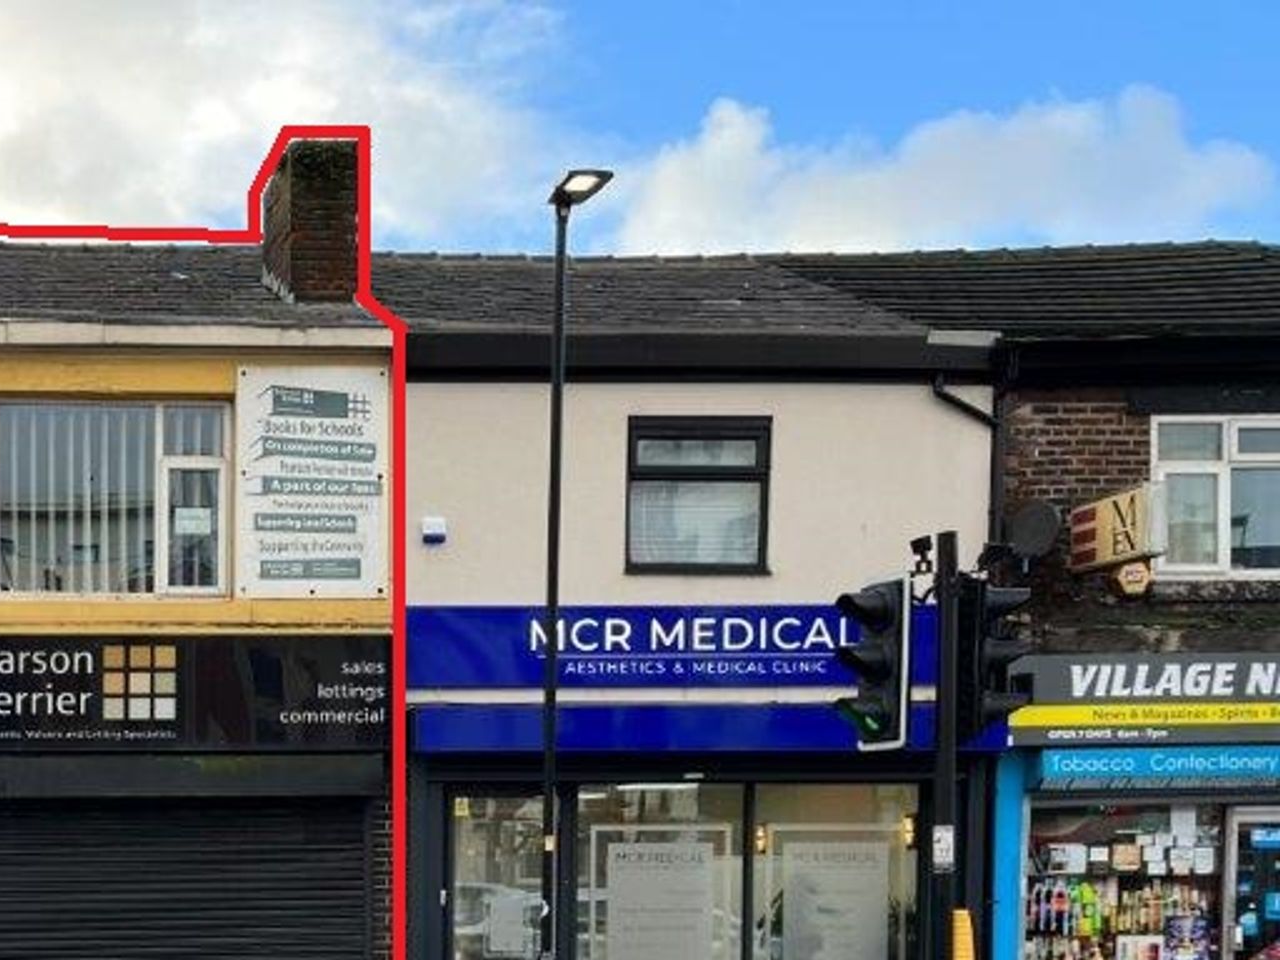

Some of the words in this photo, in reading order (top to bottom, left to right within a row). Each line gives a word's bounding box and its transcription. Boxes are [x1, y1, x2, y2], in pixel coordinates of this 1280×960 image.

[272, 479, 281, 488] A
[283, 479, 311, 492] part
[314, 480, 327, 491] of
[328, 481, 349, 491] our
[530, 618, 631, 651] MCR
[650, 616, 861, 651] MEDICAL
[341, 660, 386, 675] sales
[565, 661, 666, 675] AESTHETICS
[673, 662, 684, 675] &
[692, 661, 767, 675] MEDICAL
[772, 660, 827, 675] CLINIC
[1071, 663, 1236, 697] VILLAGE
[1245, 662, 1280, 696] N
[317, 682, 386, 702] lettings
[280, 706, 385, 724] commercial
[1052, 754, 1134, 772] Tobacco
